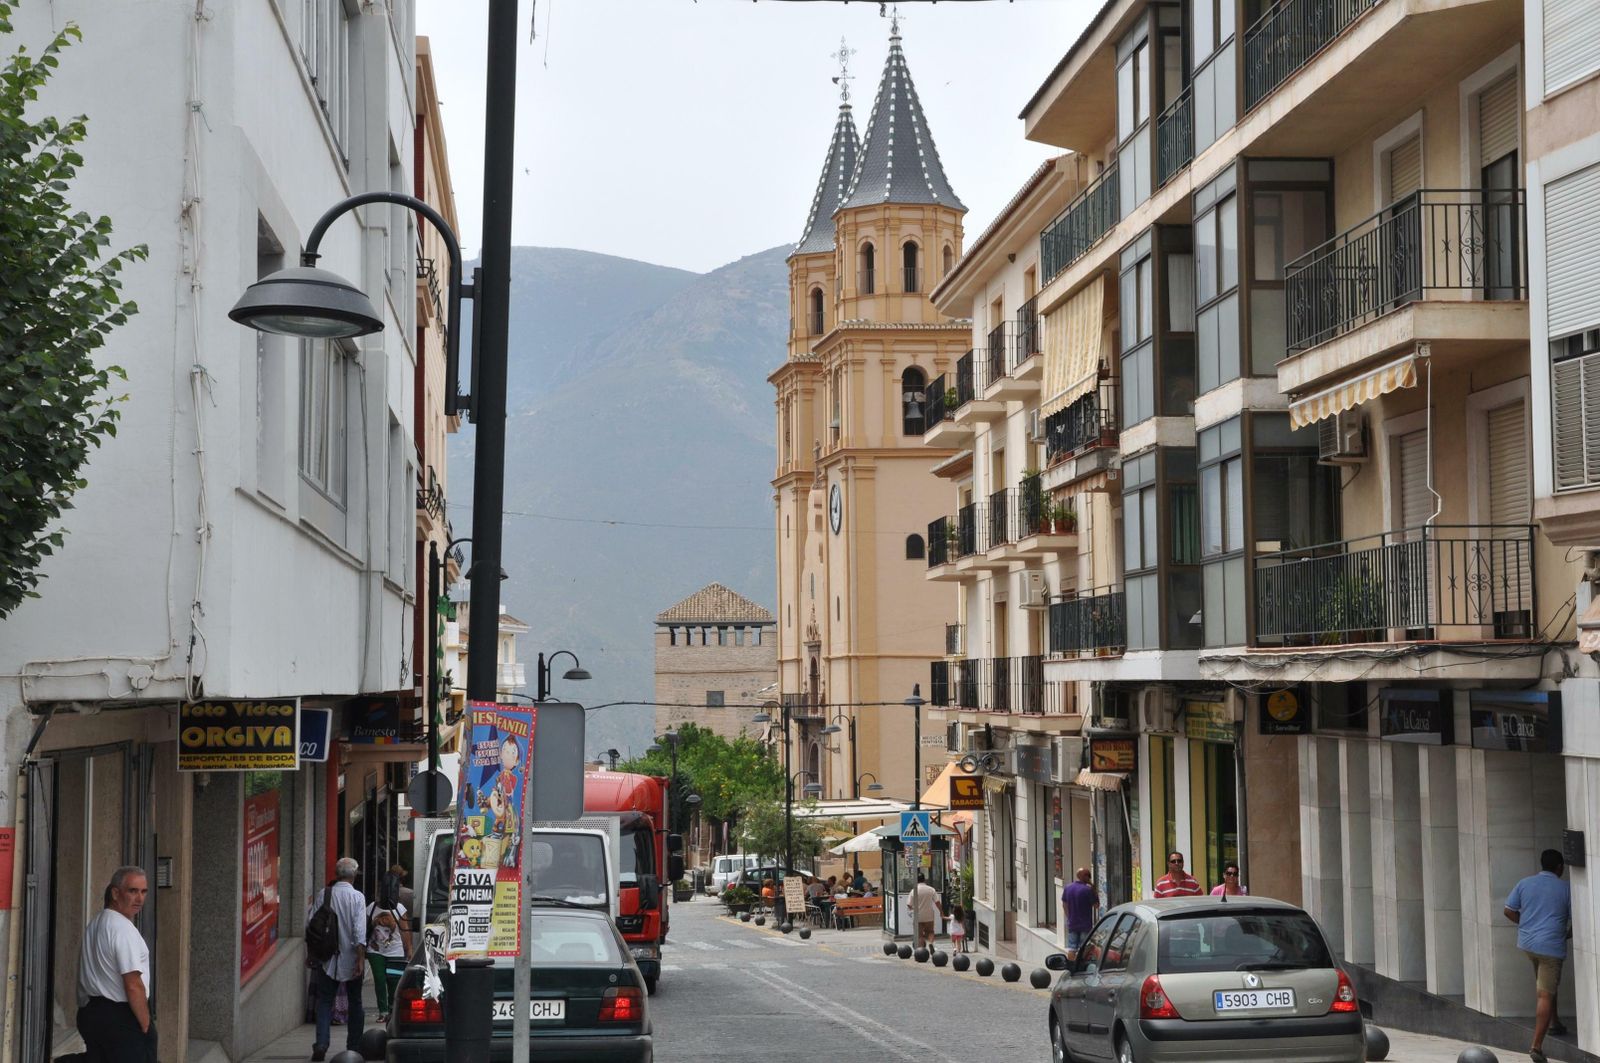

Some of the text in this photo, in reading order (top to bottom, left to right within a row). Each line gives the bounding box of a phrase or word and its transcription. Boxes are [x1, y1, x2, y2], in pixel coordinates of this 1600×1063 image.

[232, 702, 294, 717] Video
[353, 725, 396, 737] Banesto
[496, 716, 529, 737] FANTIL
[181, 726, 293, 748] ORGIVA
[300, 742, 317, 756] CO
[456, 873, 492, 885] GIVA
[460, 888, 492, 901] CINEMA
[1225, 991, 1291, 1008] 5903 CHB
[492, 1002, 561, 1017] 548 CHJ
